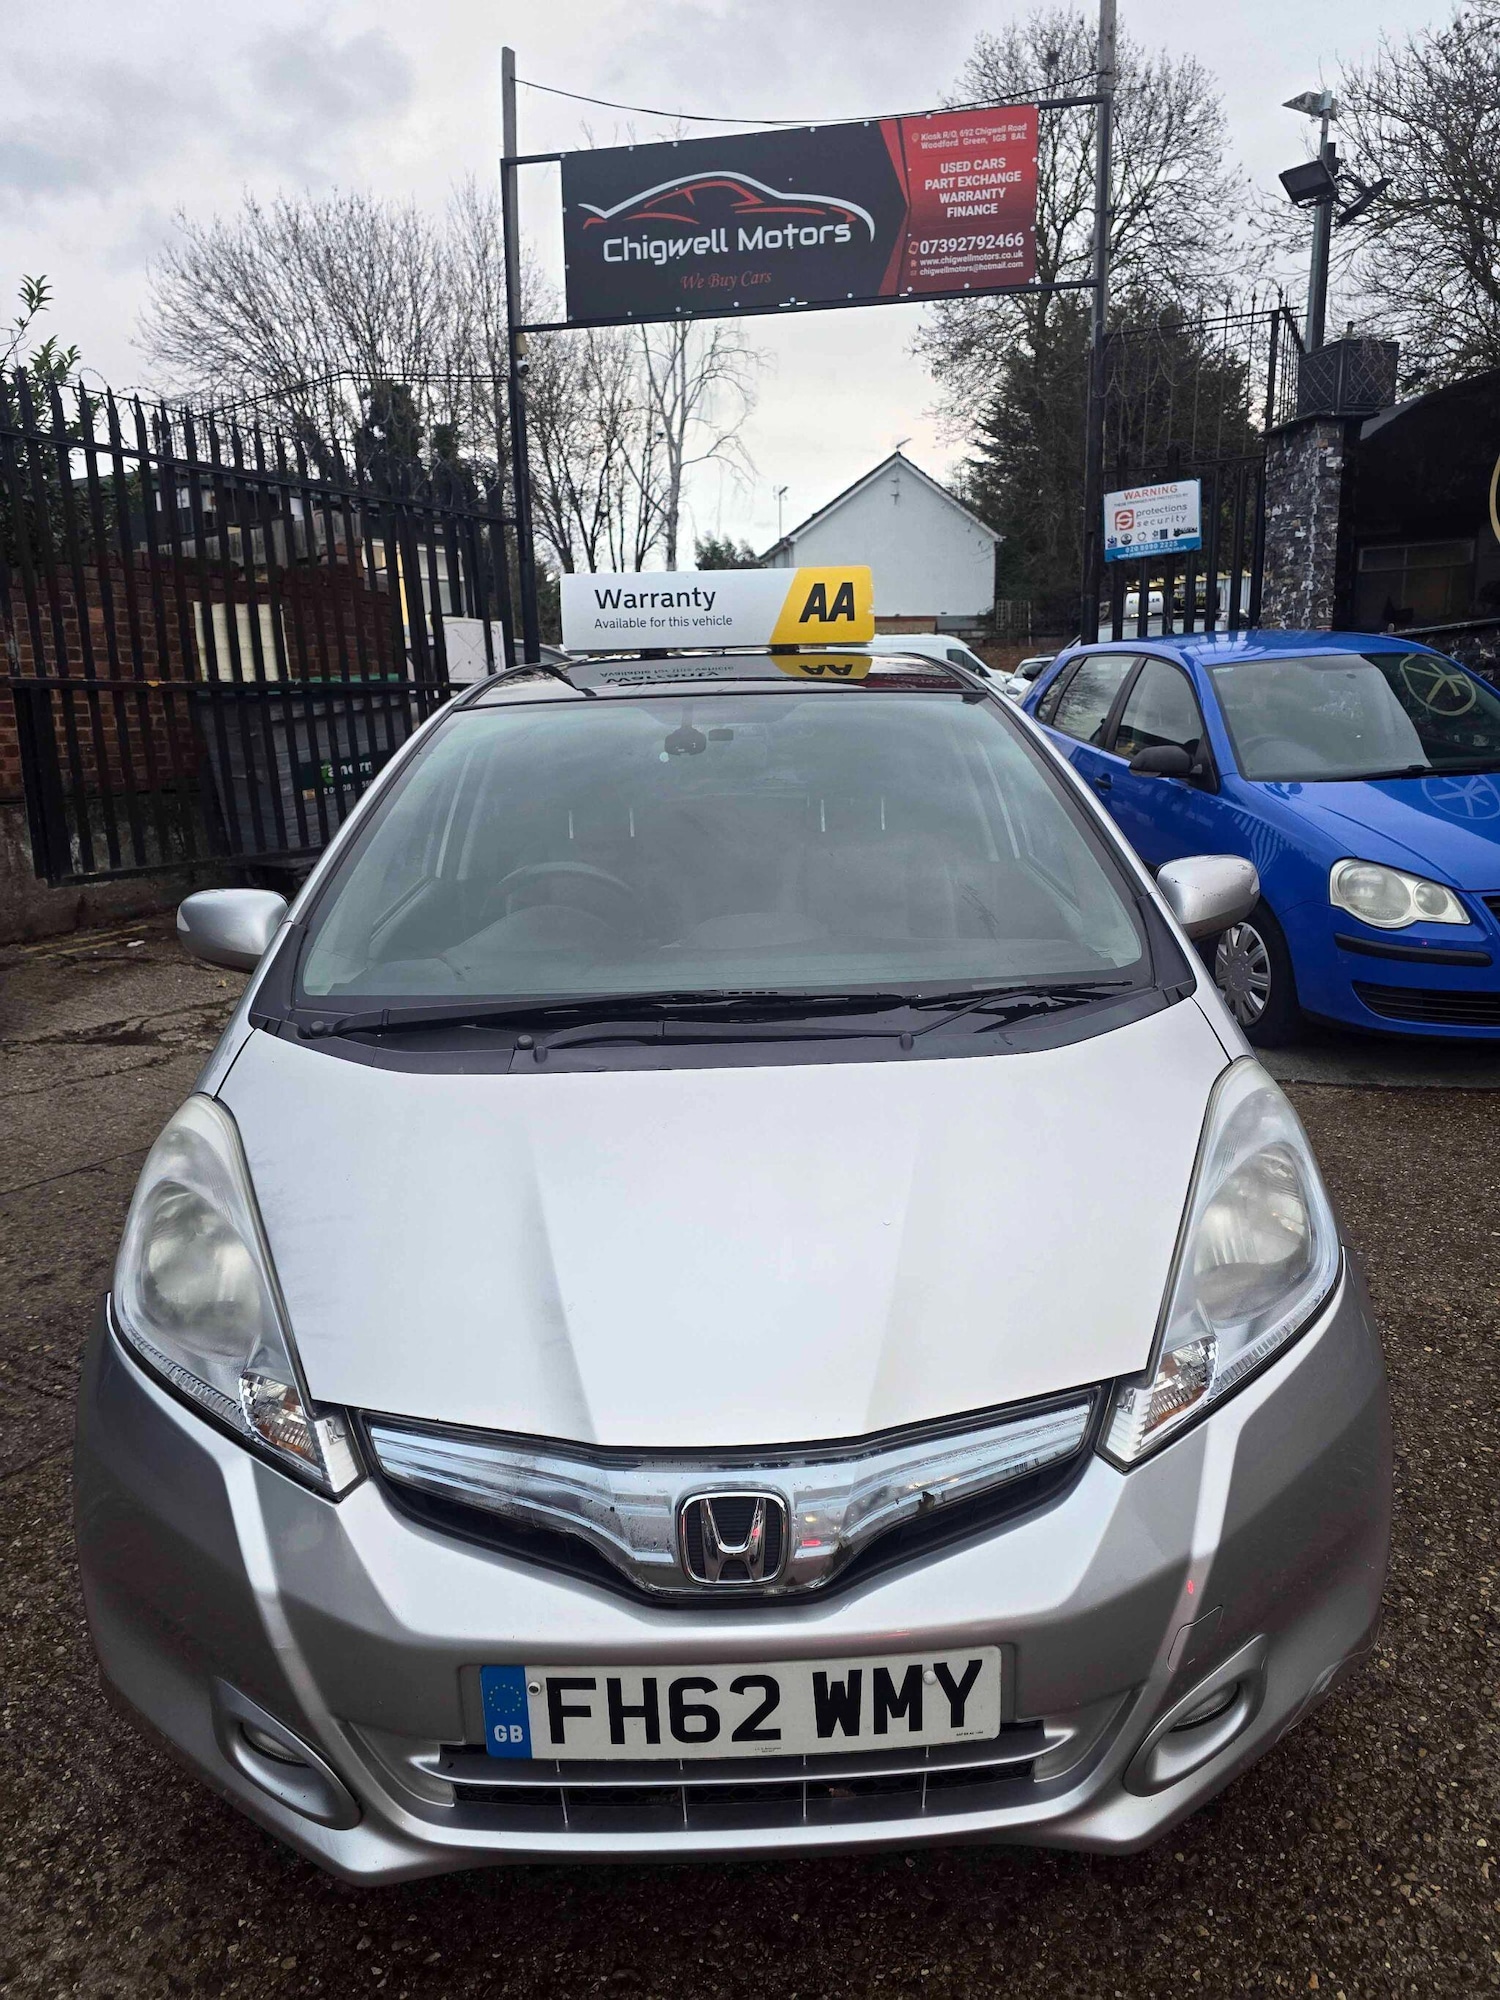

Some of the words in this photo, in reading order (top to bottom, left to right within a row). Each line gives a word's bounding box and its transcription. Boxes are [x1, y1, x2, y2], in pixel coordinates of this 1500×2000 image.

[920, 132, 942, 142] Kiosk
[960, 128, 975, 138] 692
[975, 125, 1007, 138] Chigwell
[1007, 122, 1028, 133] Road
[921, 138, 959, 150] Woodford
[992, 133, 1007, 143] IG8
[940, 160, 972, 174] USED
[973, 157, 1007, 171] CARS
[924, 177, 955, 191] PART
[957, 170, 1022, 188] EXCHANGE
[939, 187, 1007, 204] WARRANTY
[946, 203, 999, 218] FINANCE
[603, 227, 729, 266] Chigwell
[737, 222, 852, 251] Motors
[919, 232, 1025, 255] 07392792466
[919, 249, 1024, 267] www.chigwellmotors.co.uk
[919, 260, 1024, 277] chigwellmotors@hotmail.com
[680, 274, 705, 290] We
[708, 272, 738, 291] Buy
[740, 270, 772, 287] Cars
[1123, 484, 1178, 501] WARNING
[1136, 503, 1188, 518] protections
[1136, 514, 1187, 528] security
[595, 587, 717, 612] Warranty
[798, 582, 855, 623] AA
[594, 617, 648, 629] Available
[649, 615, 665, 628] for
[668, 615, 690, 627] this
[691, 614, 733, 627] vehicle
[545, 1674, 783, 1746] FH62
[811, 1658, 985, 1740] WMY
[493, 1724, 524, 1744] GB
